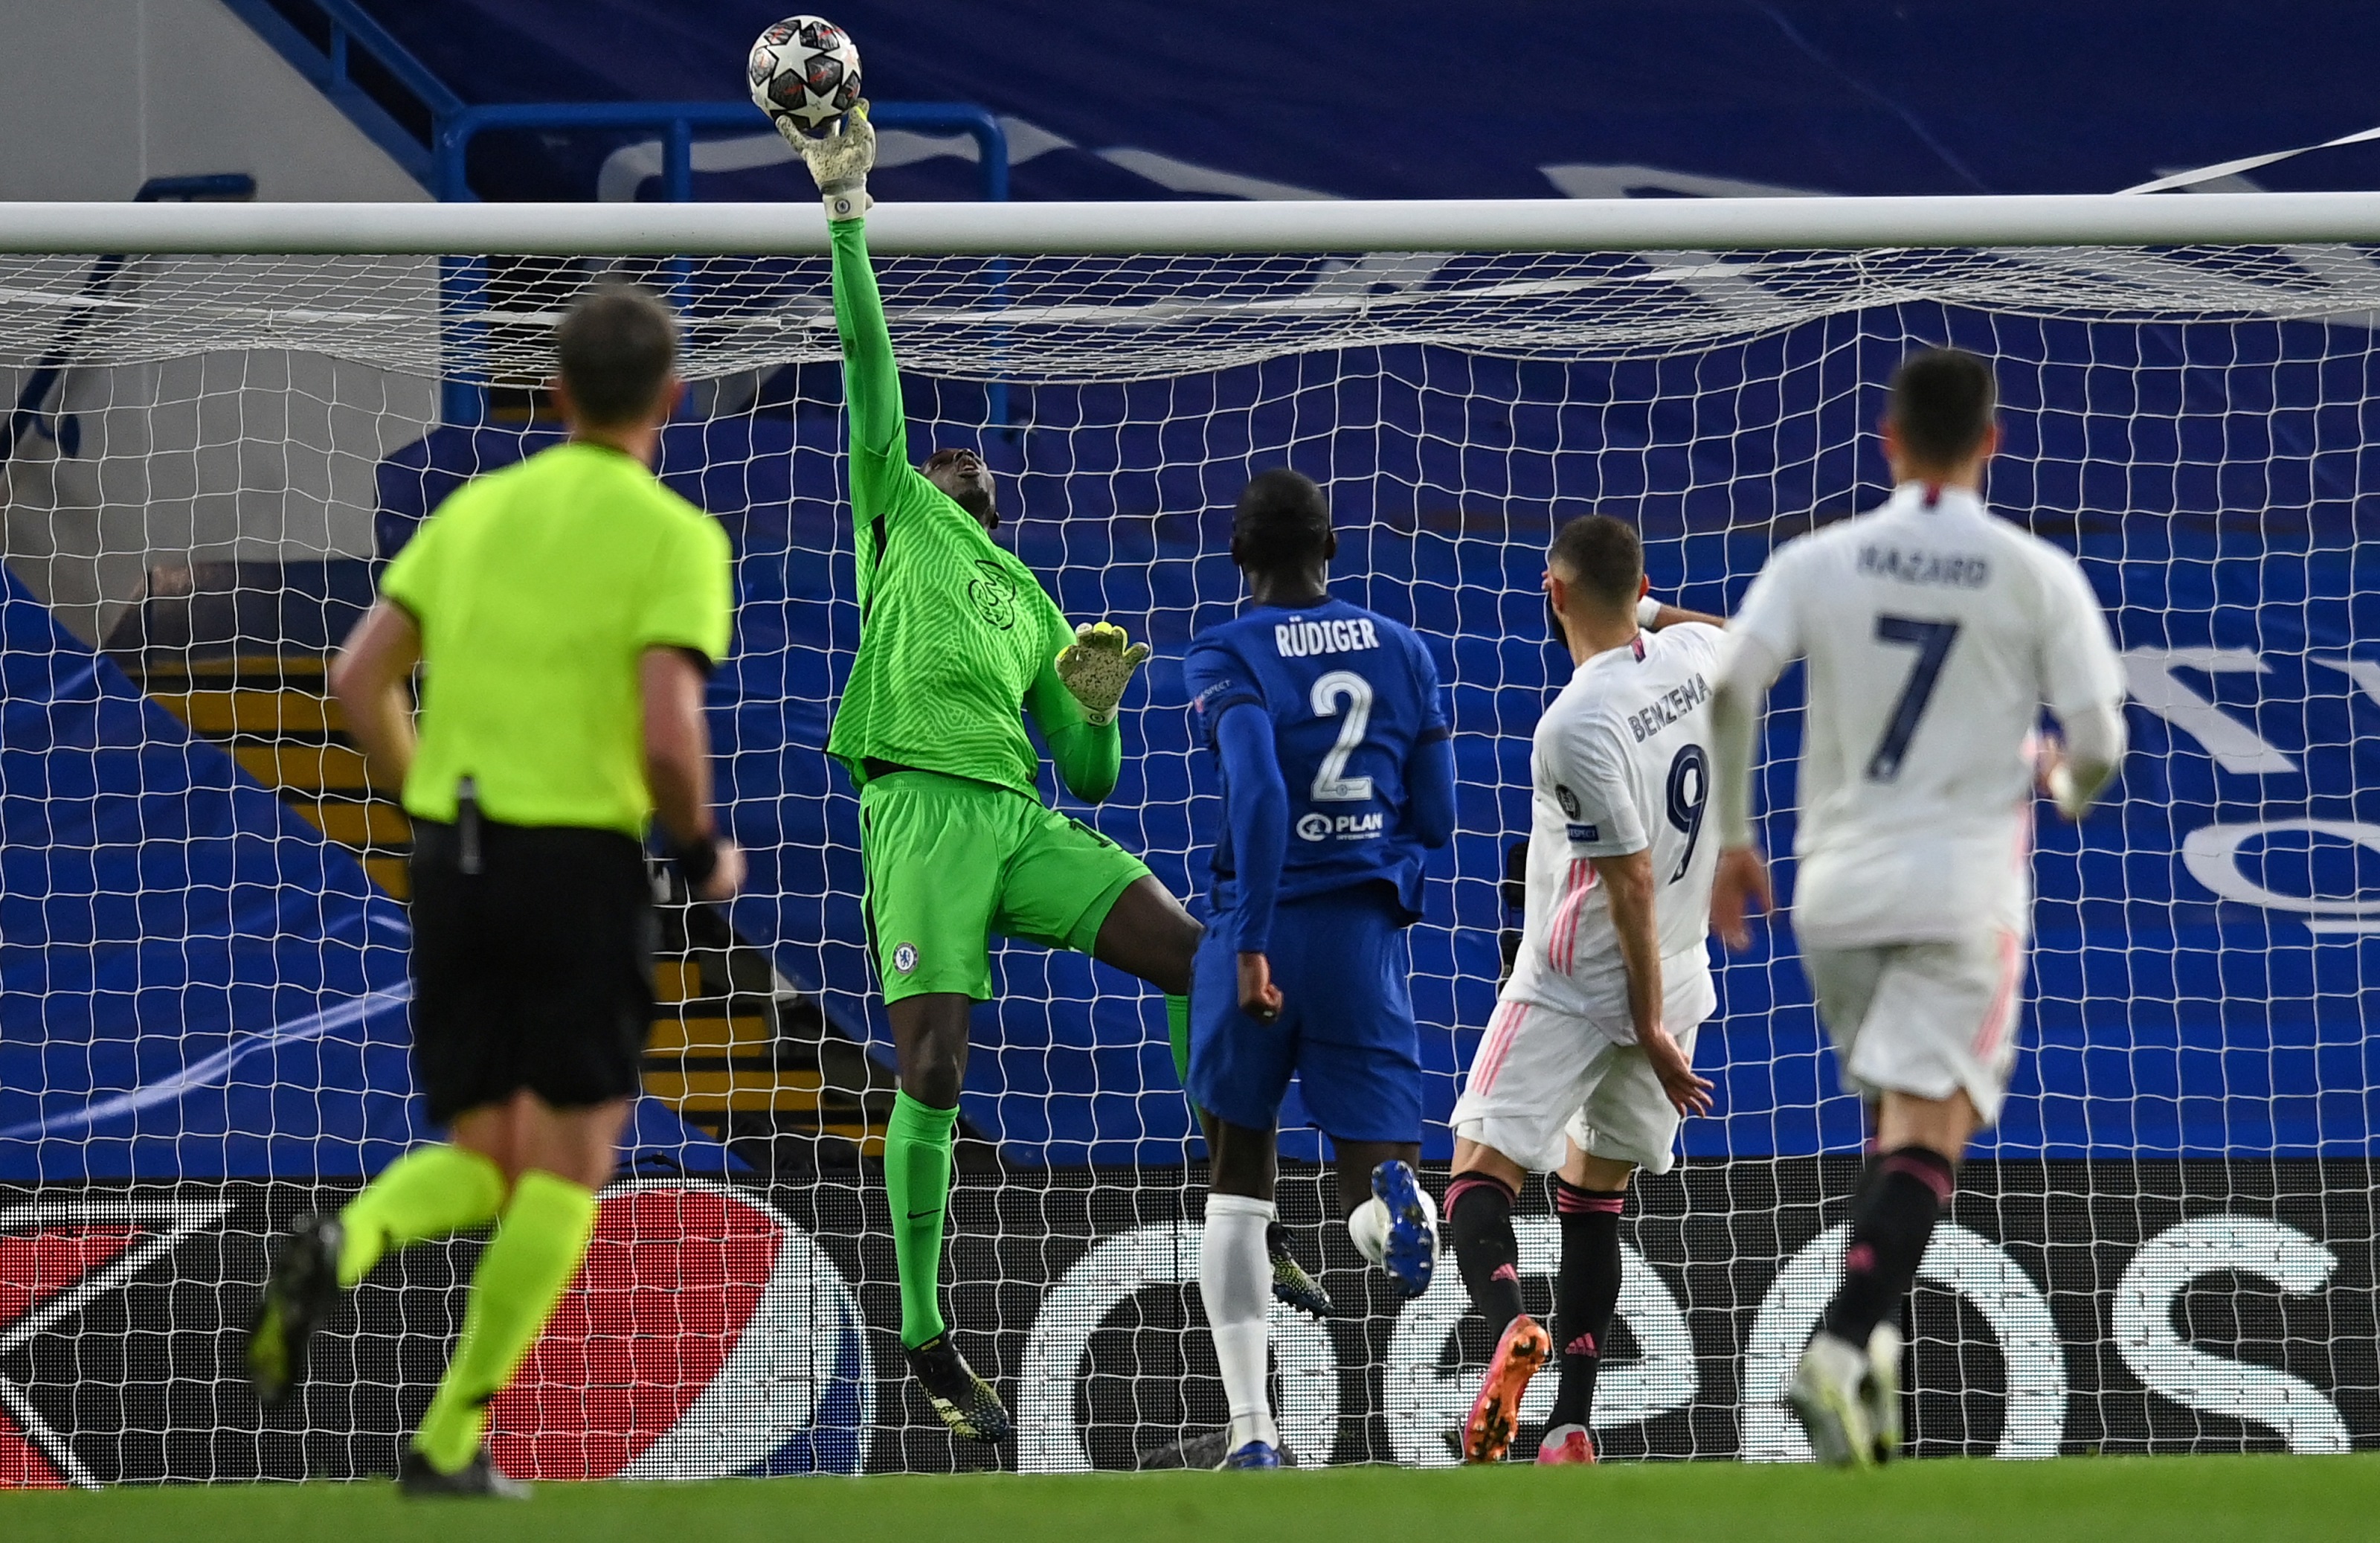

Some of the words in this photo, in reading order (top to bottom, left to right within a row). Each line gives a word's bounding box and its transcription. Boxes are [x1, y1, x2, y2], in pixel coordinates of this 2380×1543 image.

[1275, 615, 1379, 657] RÜDIGER
[1311, 671, 1374, 801] 2
[1629, 673, 1712, 742] BENZEMA
[1868, 615, 1961, 781] 7
[1335, 812, 1383, 832] PLAN
[1667, 743, 1710, 885] 9
